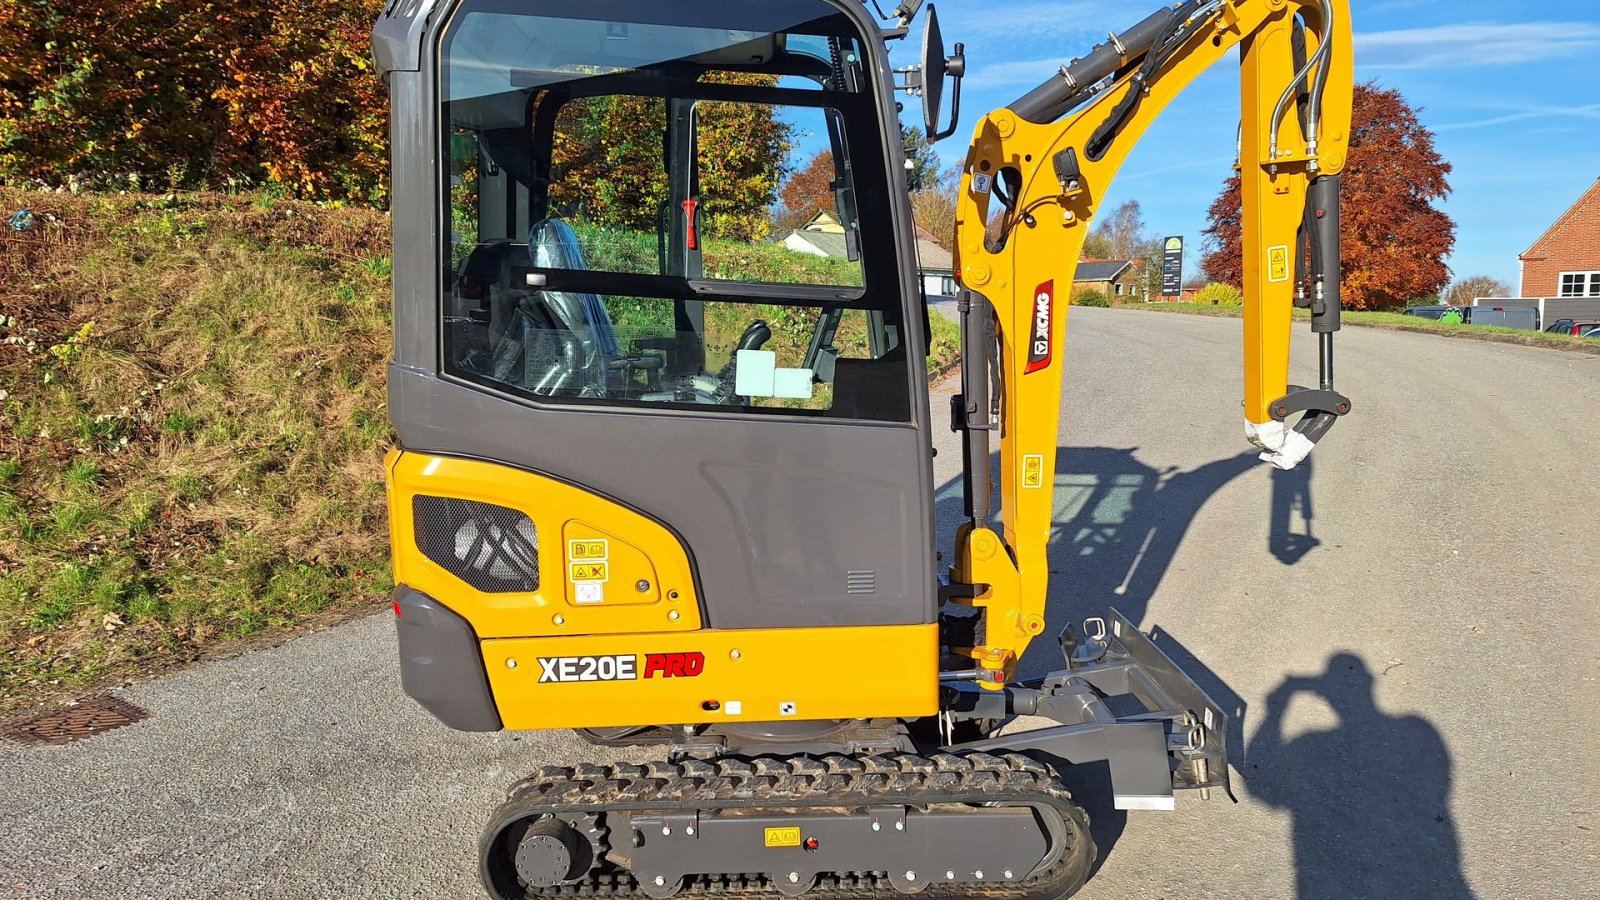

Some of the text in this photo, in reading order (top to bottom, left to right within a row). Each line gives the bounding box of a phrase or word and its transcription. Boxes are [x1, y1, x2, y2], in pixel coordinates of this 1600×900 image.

[1036, 292, 1049, 340] XCMG
[537, 652, 705, 682] XE20E PRO
